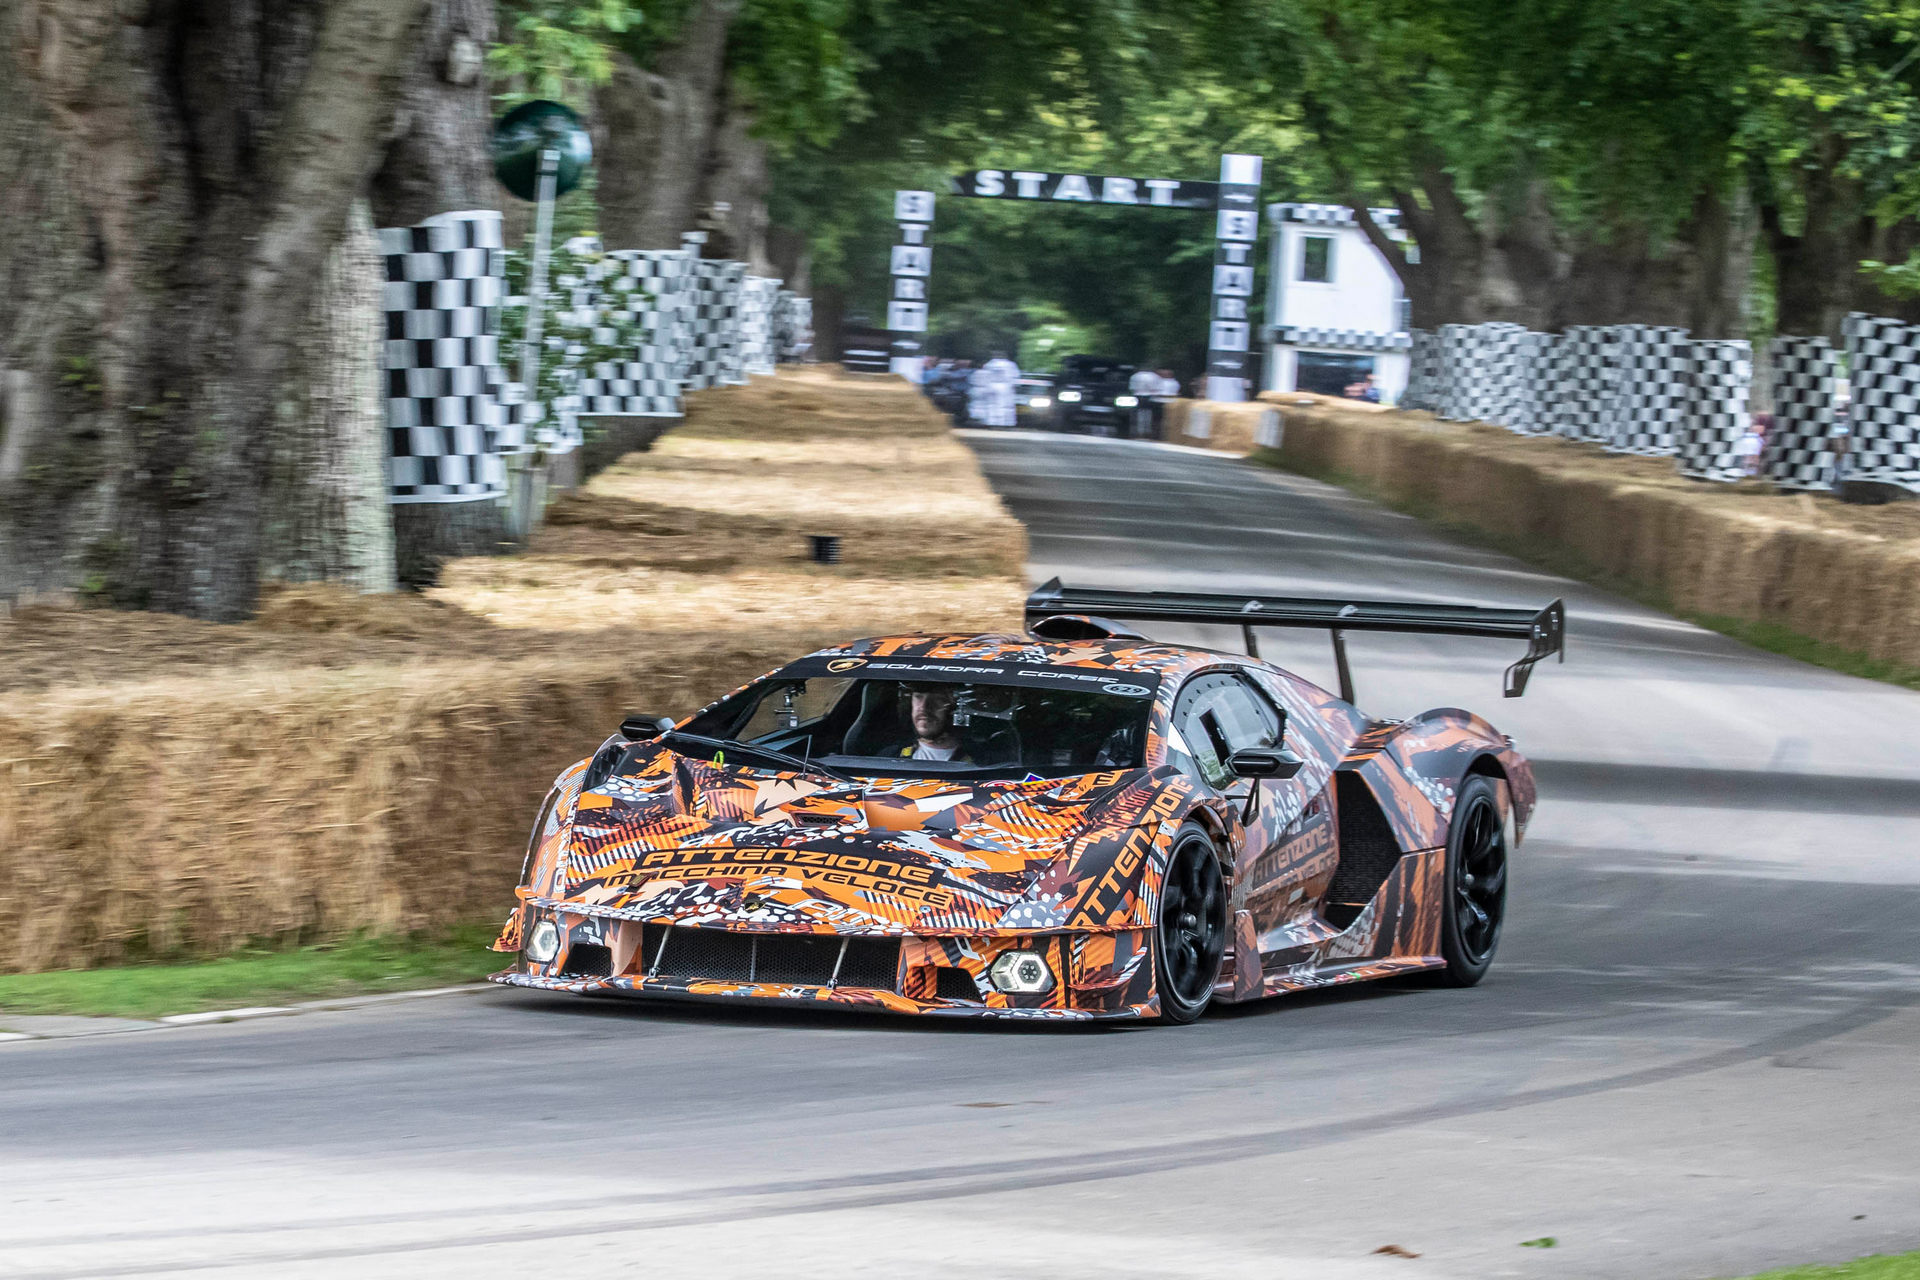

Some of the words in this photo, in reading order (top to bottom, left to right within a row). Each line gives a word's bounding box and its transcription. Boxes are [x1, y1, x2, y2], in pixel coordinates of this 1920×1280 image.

[974, 169, 1181, 206] START
[891, 192, 932, 330] START
[1212, 212, 1255, 349] START
[867, 662, 1004, 674] SQUADRA
[1017, 670, 1119, 684] CORSE
[1109, 685, 1143, 694] 629
[641, 848, 934, 884] ATTENZIONE
[1070, 777, 1194, 926] ATTENZIONE
[802, 868, 951, 907] VELOCE
